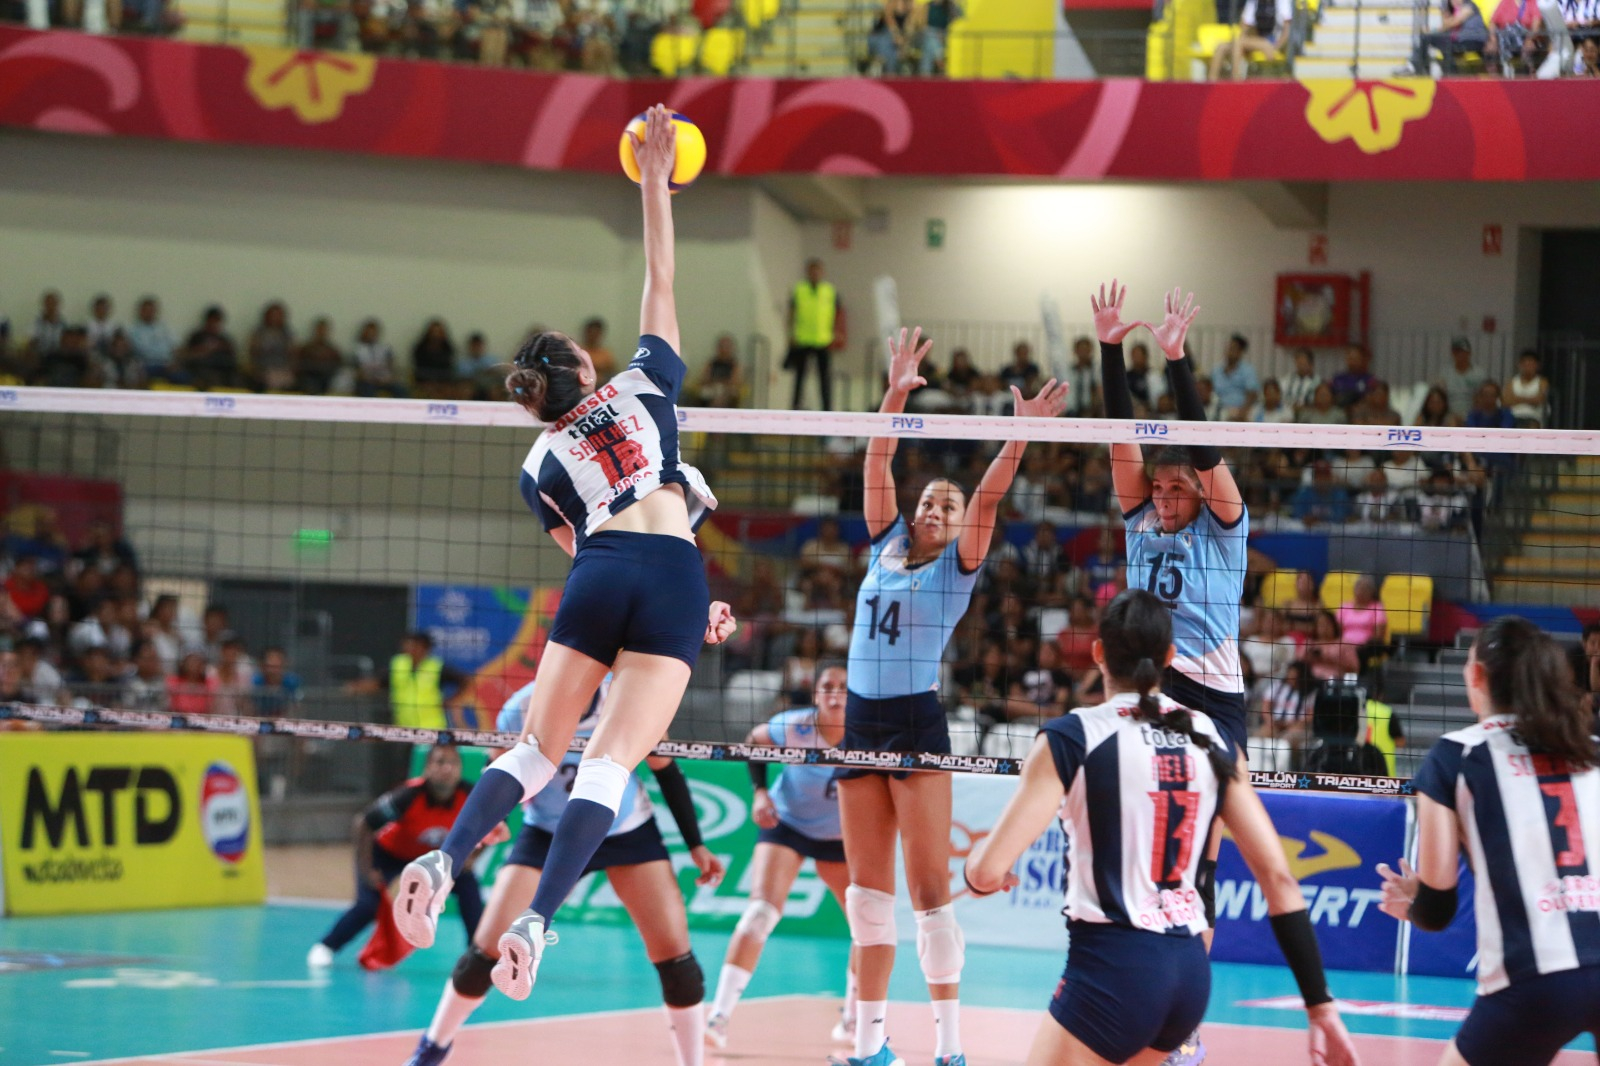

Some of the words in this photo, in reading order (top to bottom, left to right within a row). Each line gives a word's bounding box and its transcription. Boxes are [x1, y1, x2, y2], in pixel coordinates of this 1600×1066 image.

[568, 403, 620, 439] total
[892, 416, 923, 428] FIVB
[1135, 423, 1168, 434] FIVB
[569, 414, 644, 461] SANCHEZ
[1388, 429, 1422, 441] FIVB
[1147, 552, 1185, 600] 15
[865, 595, 901, 646] 14
[1141, 726, 1189, 747] tota
[656, 742, 712, 755] ATHLON
[728, 744, 806, 758] TRIATHLON
[824, 749, 901, 762] TRIATHLON
[919, 752, 998, 768] TRIATHLON
[971, 766, 997, 774] SPORT
[1249, 772, 1297, 784] THLON
[1315, 775, 1400, 789] TRIATHLON
[20, 765, 184, 849] MTD
[1538, 781, 1586, 867] 3
[1147, 789, 1200, 883] 13
[1214, 879, 1386, 928] NVERT
